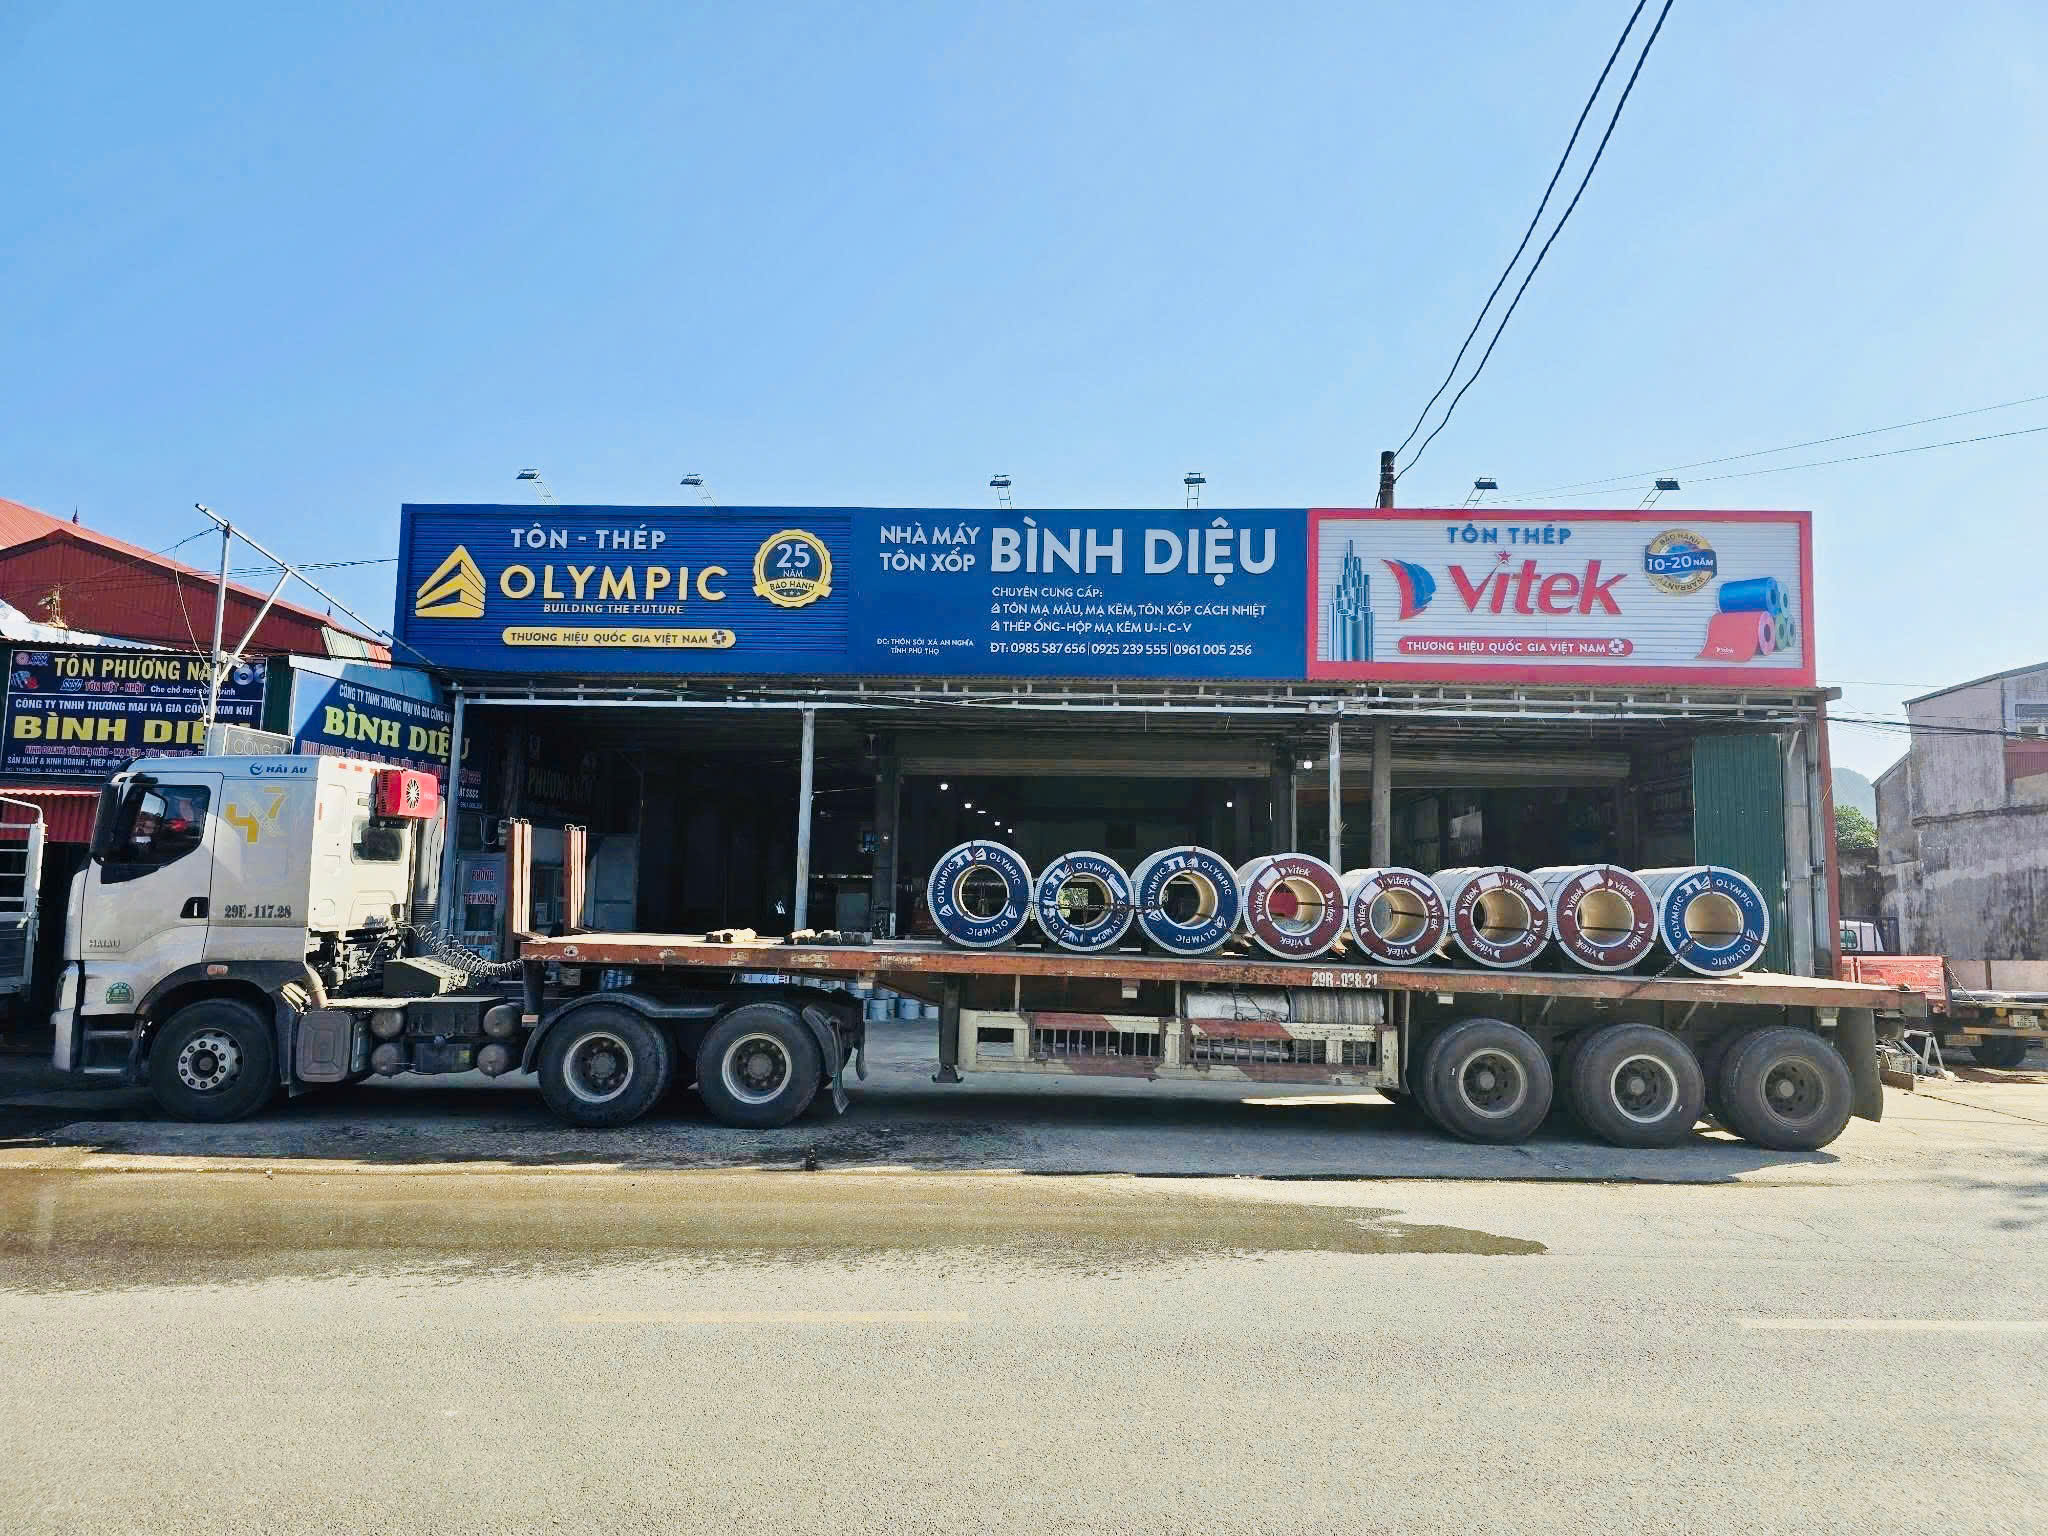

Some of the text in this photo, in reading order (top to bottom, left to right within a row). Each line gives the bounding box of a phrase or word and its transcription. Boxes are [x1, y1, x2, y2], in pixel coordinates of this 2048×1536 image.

[510, 523, 568, 549] TÔN
[595, 523, 665, 550] THÉP
[880, 521, 980, 545] NHÀ MÁY
[1447, 523, 1572, 545] TÔN THÉP
[776, 543, 810, 568] 25
[879, 546, 976, 572] TÔN XỐP
[990, 516, 1276, 587] BÌNH DIỆU
[1648, 555, 1713, 570] 10-20 NĂM
[499, 564, 729, 601] OLYMPIC
[783, 568, 803, 577] NĂM
[992, 585, 1103, 598] CHUYÊN CUNG CẤP:
[543, 604, 683, 614] BUILDING THE FUTURE
[1003, 602, 1028, 614] TÔN
[1030, 604, 1050, 616] MẠ
[1053, 602, 1084, 617] MÀU,
[1085, 604, 1105, 617] MẠ
[1139, 602, 1164, 615] TÔN
[1166, 600, 1191, 616] XỐP
[1194, 603, 1229, 616] CÁCH
[1232, 603, 1267, 618] NHIỆT
[511, 629, 708, 645] THƯƠNG HIỆU QUỐC GIA VIỆT NAM
[1003, 619, 1031, 631] THÉP
[1033, 618, 1092, 634] ỐNG-HỘP
[1094, 623, 1114, 635] MẠ
[990, 643, 1252, 656] ĐT: 0985 587 656 0925 239 555 0961 005 256
[1407, 638, 1606, 655] THƯƠNG HIỆU QUỐC GIA VIỆT NAM
[54, 653, 95, 677] TÔN
[101, 656, 181, 680] PHƯƠNG
[150, 685, 165, 693] Che
[357, 689, 364, 702] TY
[15, 698, 42, 709] CÔNG
[44, 700, 57, 709] TY
[59, 700, 85, 710] TNHH
[87, 701, 126, 711] THƯƠNG
[128, 702, 148, 714] MẠI
[150, 702, 163, 712] VÀ
[165, 704, 182, 713] GIA
[235, 704, 253, 716] KHÍ
[13, 711, 127, 741] BÌNH
[990, 852, 1021, 885] OLYMPIC
[1201, 861, 1232, 896] OLYMPIC
[937, 863, 955, 904] OLYMPIC
[1715, 879, 1754, 908] OLYMPIC
[1670, 895, 1684, 939] OLYMPIC
